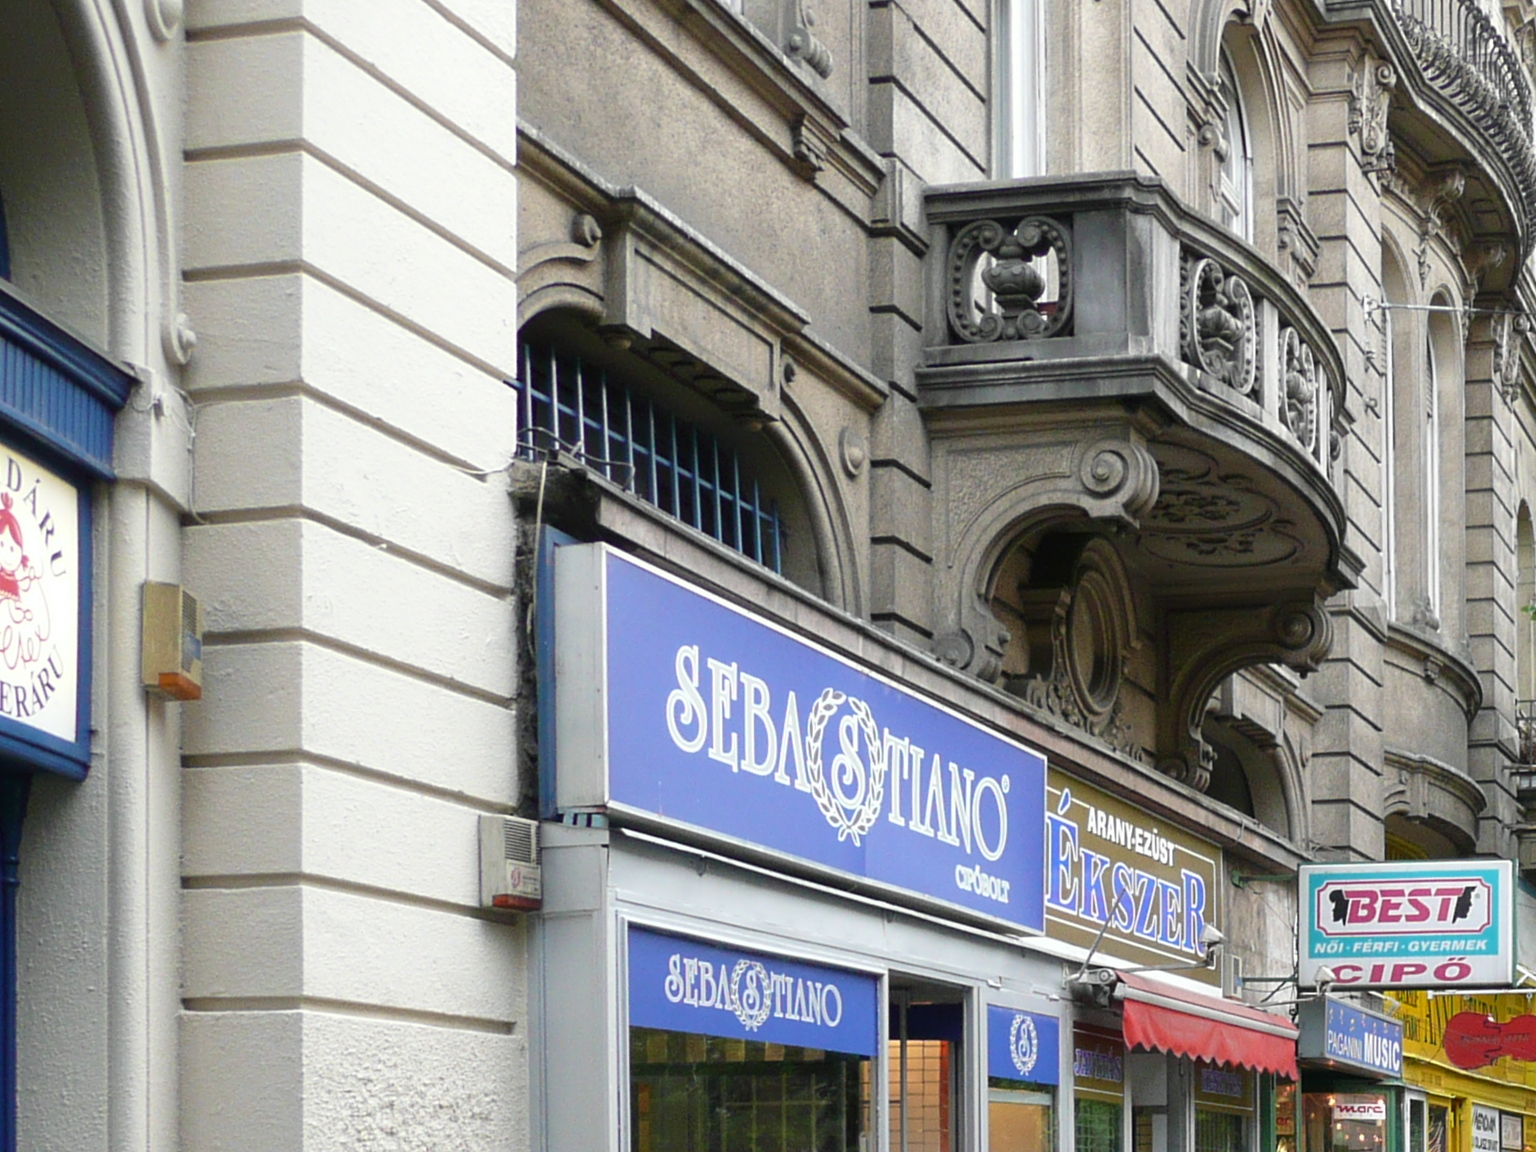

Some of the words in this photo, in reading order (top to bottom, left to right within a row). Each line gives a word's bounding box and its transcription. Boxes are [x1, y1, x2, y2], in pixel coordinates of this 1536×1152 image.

[666, 645, 1010, 861] SEBASTIANO
[1045, 787, 1208, 958] ÉKSZER
[1344, 887, 1465, 924] BEST
[1314, 938, 1343, 954] NŐI
[1352, 938, 1399, 953] FÉRFI
[1407, 938, 1488, 953] GYERMEK
[664, 953, 843, 1030] SEBASTIANO
[1331, 957, 1472, 984] CIPŐ
[1328, 1029, 1362, 1061] PAGANINI
[1364, 1031, 1400, 1072] MUSIC
